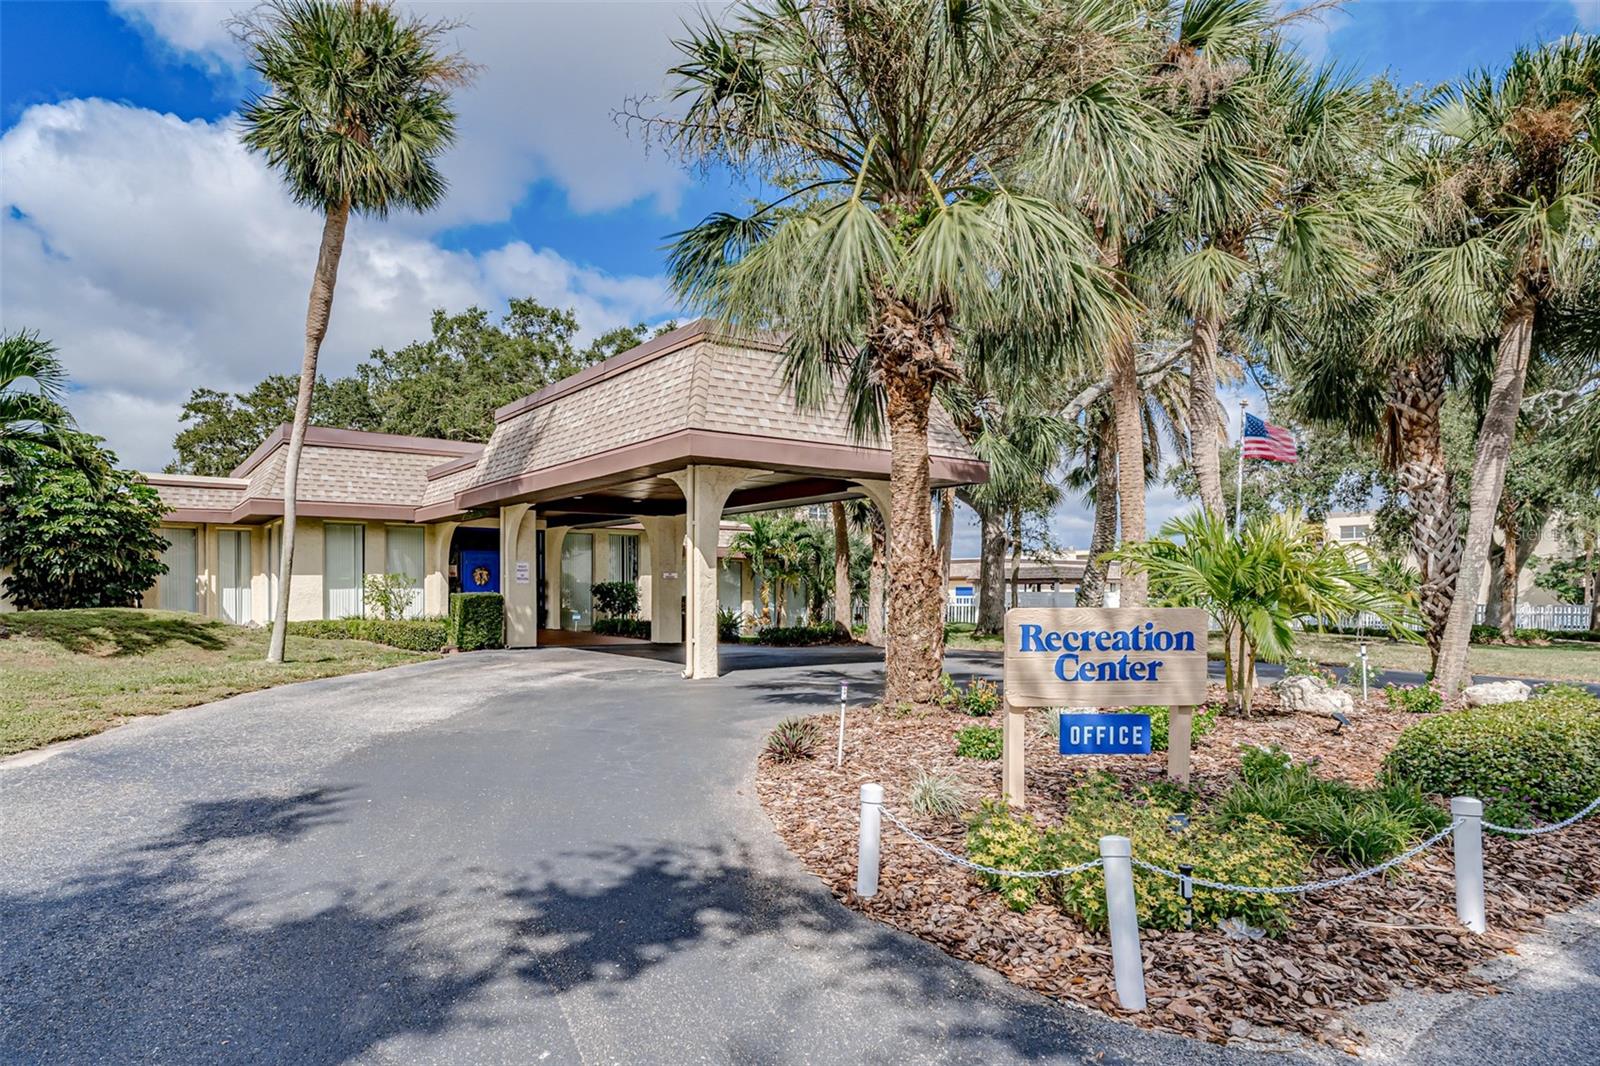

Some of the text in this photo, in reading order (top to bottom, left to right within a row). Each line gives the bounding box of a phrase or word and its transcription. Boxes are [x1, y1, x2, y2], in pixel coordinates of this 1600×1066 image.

[1019, 622, 1196, 652] Recreation
[1054, 653, 1163, 681] Center
[1070, 726, 1143, 745] OFFICE
